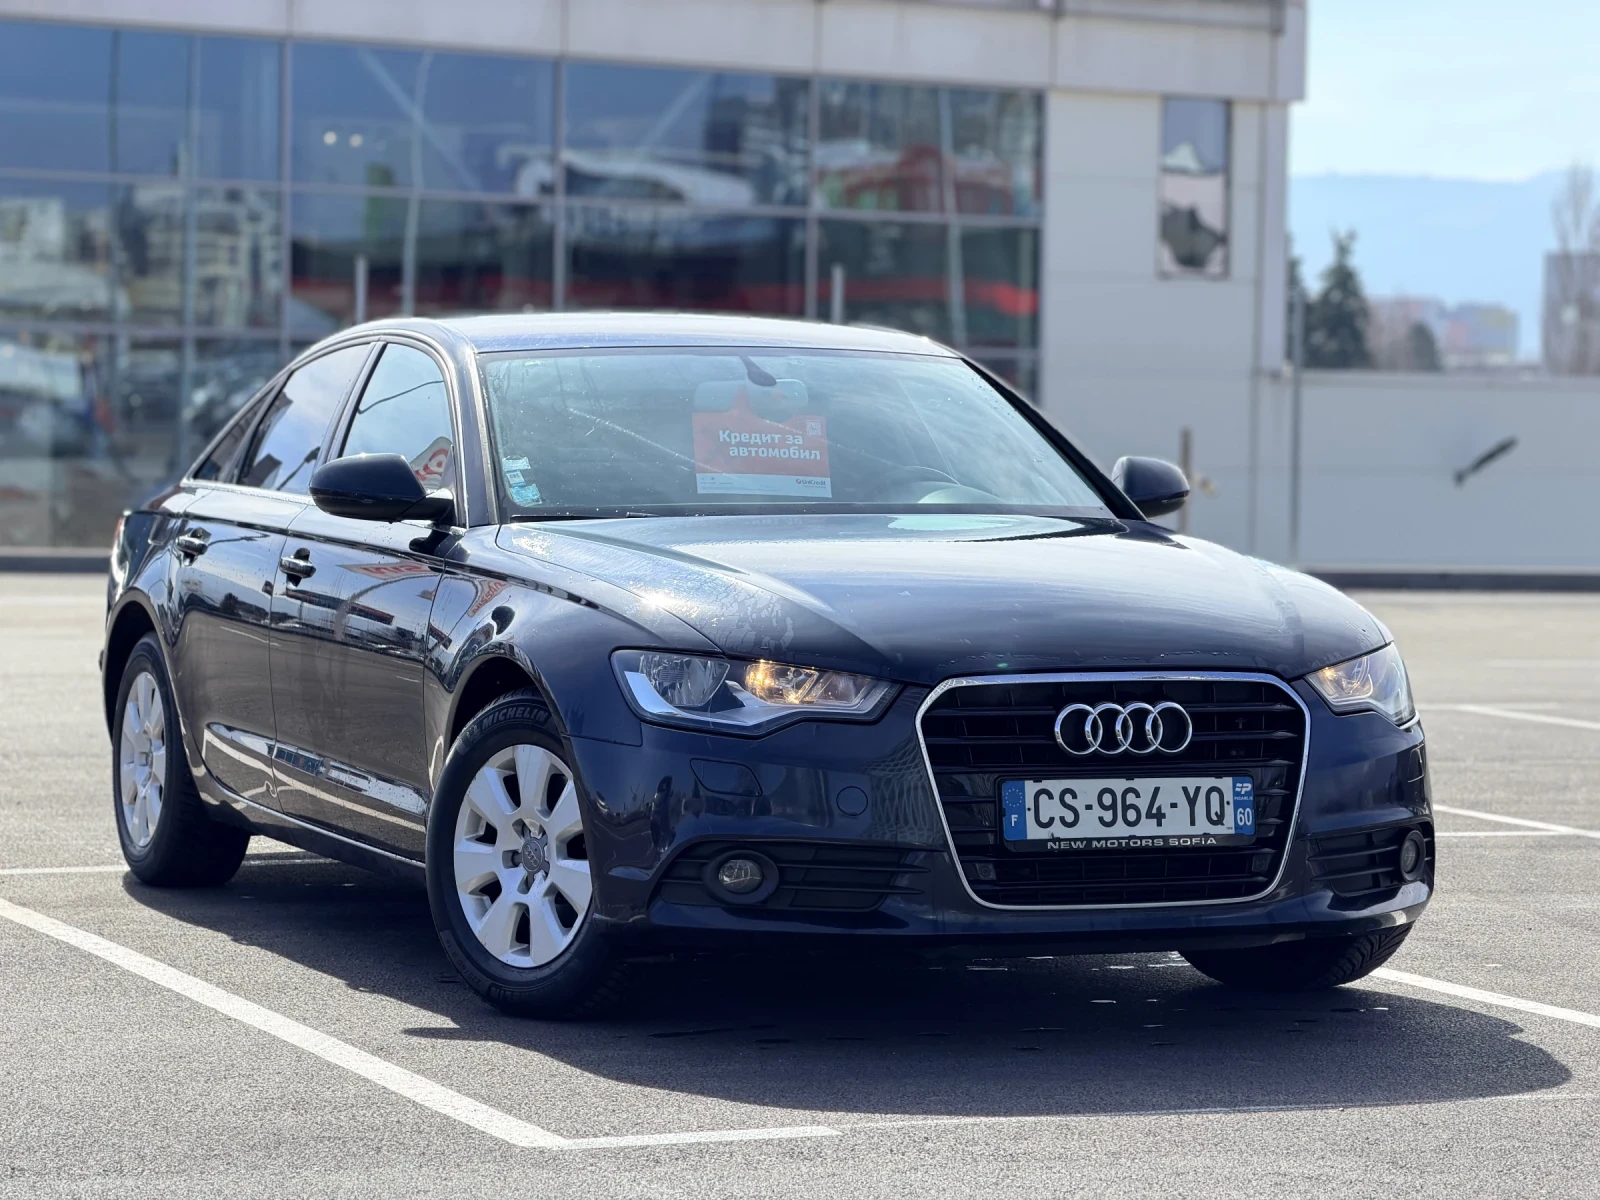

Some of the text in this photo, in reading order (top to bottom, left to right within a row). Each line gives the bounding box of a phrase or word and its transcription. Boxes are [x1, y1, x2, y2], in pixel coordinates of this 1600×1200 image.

[719, 430, 803, 444] Кредит за
[729, 446, 821, 460] автомобил
[482, 706, 549, 730] MICHELIN
[1033, 785, 1226, 829] CS-964-YQ
[1011, 814, 1018, 827] F
[1236, 807, 1253, 826] 60
[1047, 837, 1217, 849] NEW MOTORS SOFIA
